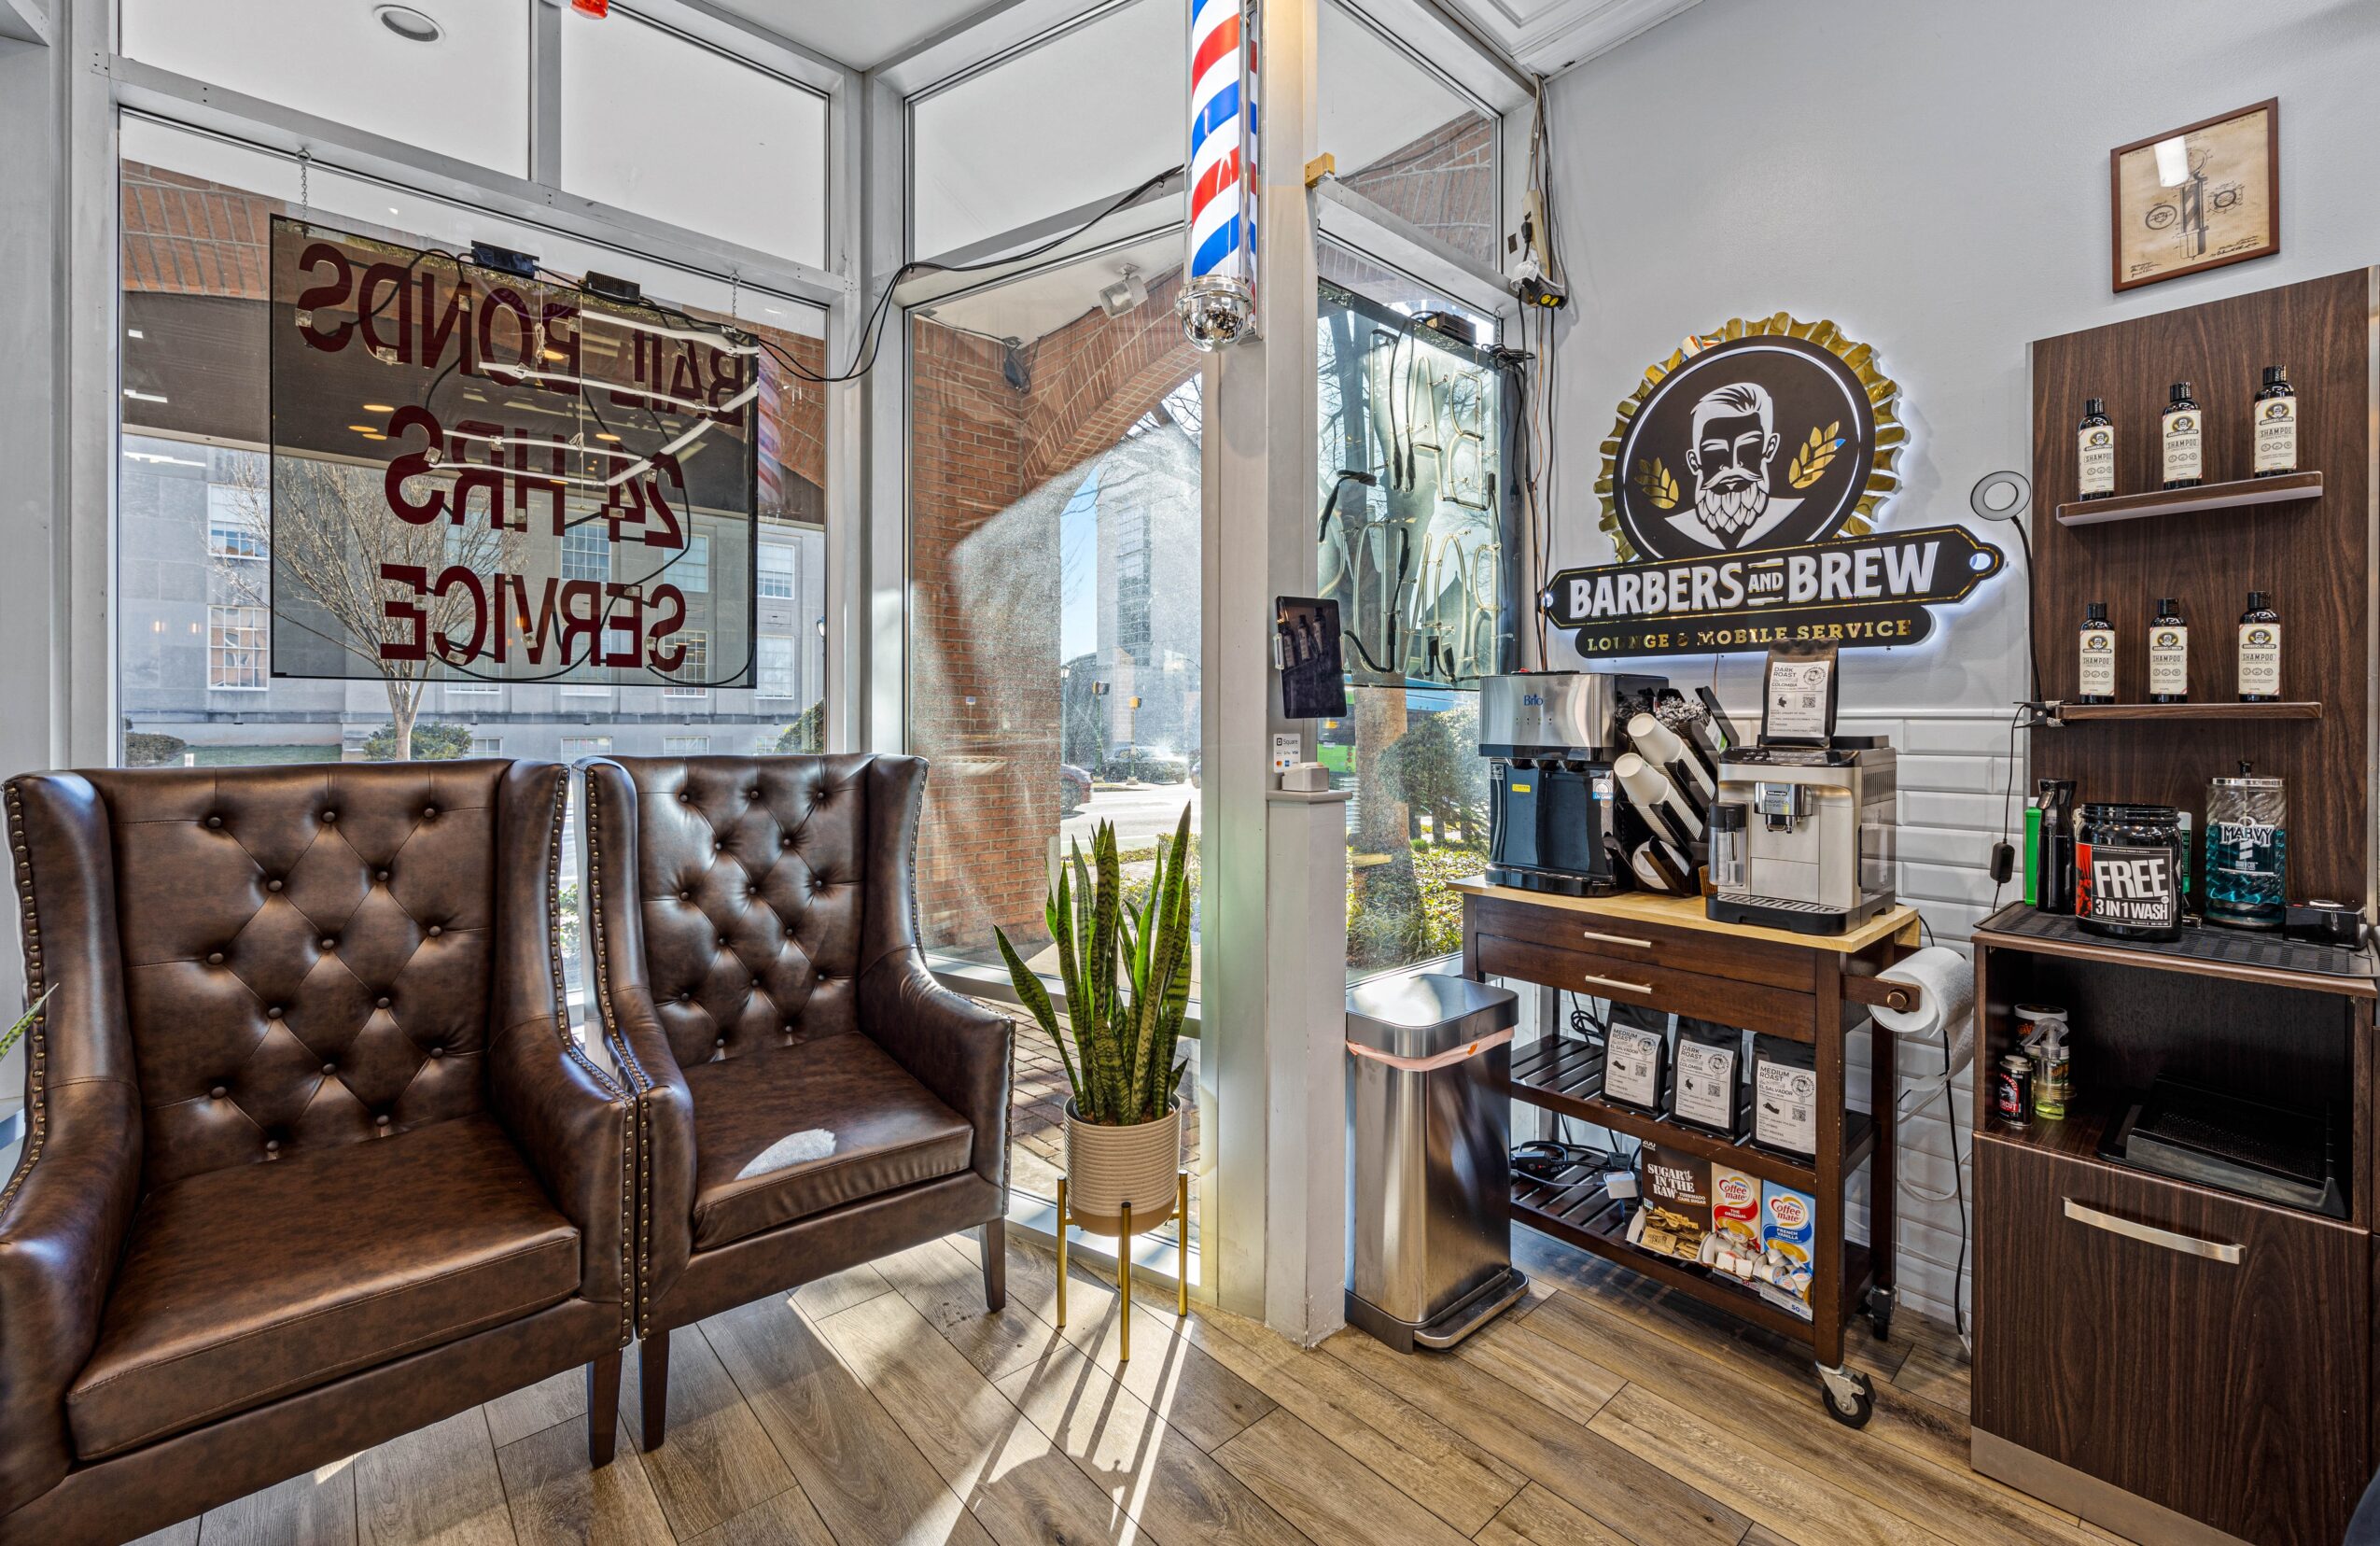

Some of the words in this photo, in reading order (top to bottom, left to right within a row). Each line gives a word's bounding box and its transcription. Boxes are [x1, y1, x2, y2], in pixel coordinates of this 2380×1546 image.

[2260, 428, 2291, 438] SHAMPOO
[2167, 439, 2197, 449] SHAMPOO
[1569, 561, 1746, 620] BARBERS
[1748, 571, 1785, 594] AND
[1788, 541, 1939, 604] BREW
[1588, 633, 1670, 652] LOUNGE
[1697, 625, 1788, 646] MOBILE
[1797, 618, 1912, 640] SERVICE
[1523, 694, 1544, 707] Brio
[2219, 825, 2275, 848] MARVY
[2093, 858, 2169, 899] FREE
[2095, 898, 2104, 915] 3
[2107, 900, 2121, 918] IN
[2121, 902, 2129, 919] 1
[2129, 903, 2168, 921] WASH
[1612, 1033, 1631, 1042] ROAST
[1613, 1029, 1638, 1039] MEDIUM
[1681, 1045, 1700, 1054] DARK
[1681, 1050, 1702, 1060] ROAST
[1759, 1066, 1790, 1078] MEDIUM
[1759, 1072, 1784, 1081] ROAST
[1765, 1086, 1793, 1096] SALVADOR
[1647, 1163, 1685, 1181] SUGAR
[1655, 1174, 1667, 1188] IN
[1668, 1177, 1695, 1193] THE
[1718, 1179, 1747, 1195] Coffee
[1652, 1183, 1677, 1200] RAW
[1725, 1191, 1746, 1202] mate
[1771, 1199, 1801, 1216] Coffee
[1776, 1212, 1799, 1222] mate
[1776, 1228, 1799, 1236] FRENCH
[1777, 1232, 1799, 1241] VANILLA
[1791, 1304, 1800, 1313] 50
